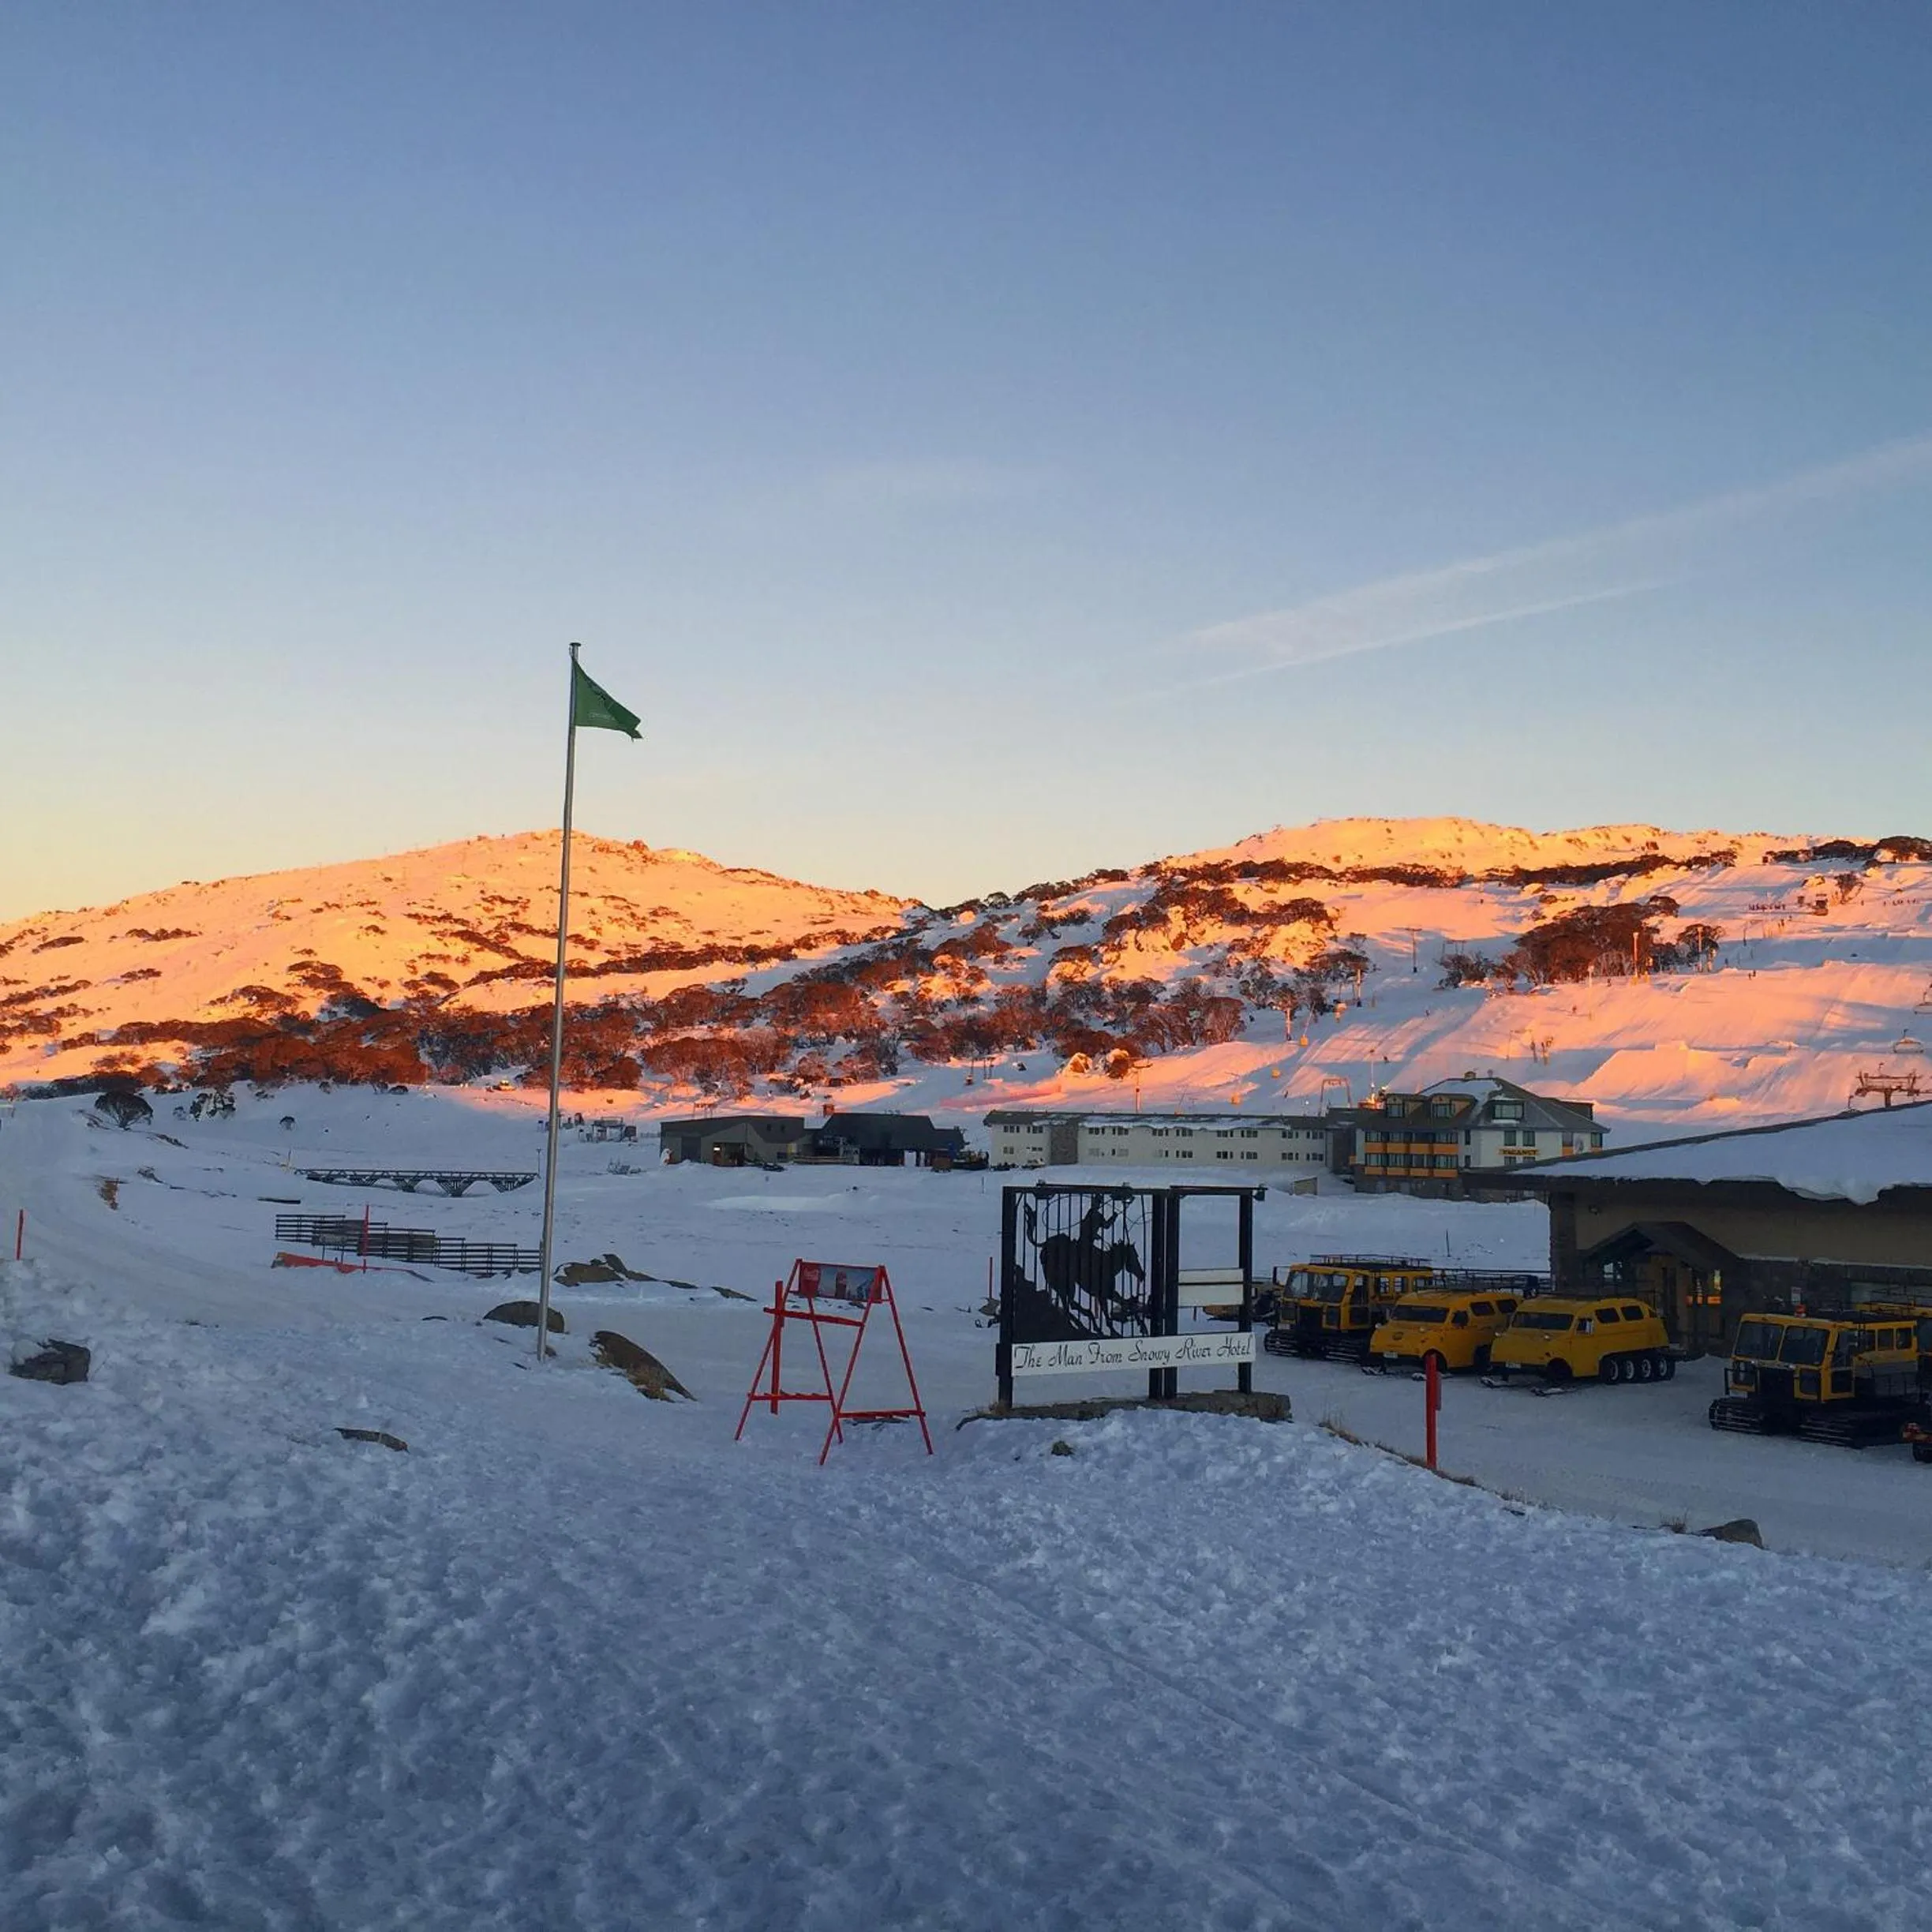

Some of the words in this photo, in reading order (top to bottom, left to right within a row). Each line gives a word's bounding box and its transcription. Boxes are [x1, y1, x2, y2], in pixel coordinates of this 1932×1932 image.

[1014, 1342, 1043, 1368] The
[1048, 1343, 1083, 1367] Man
[1088, 1342, 1123, 1365] From
[1128, 1336, 1170, 1365] Snowy
[1175, 1335, 1212, 1359] River
[1216, 1335, 1252, 1357] Hotel
